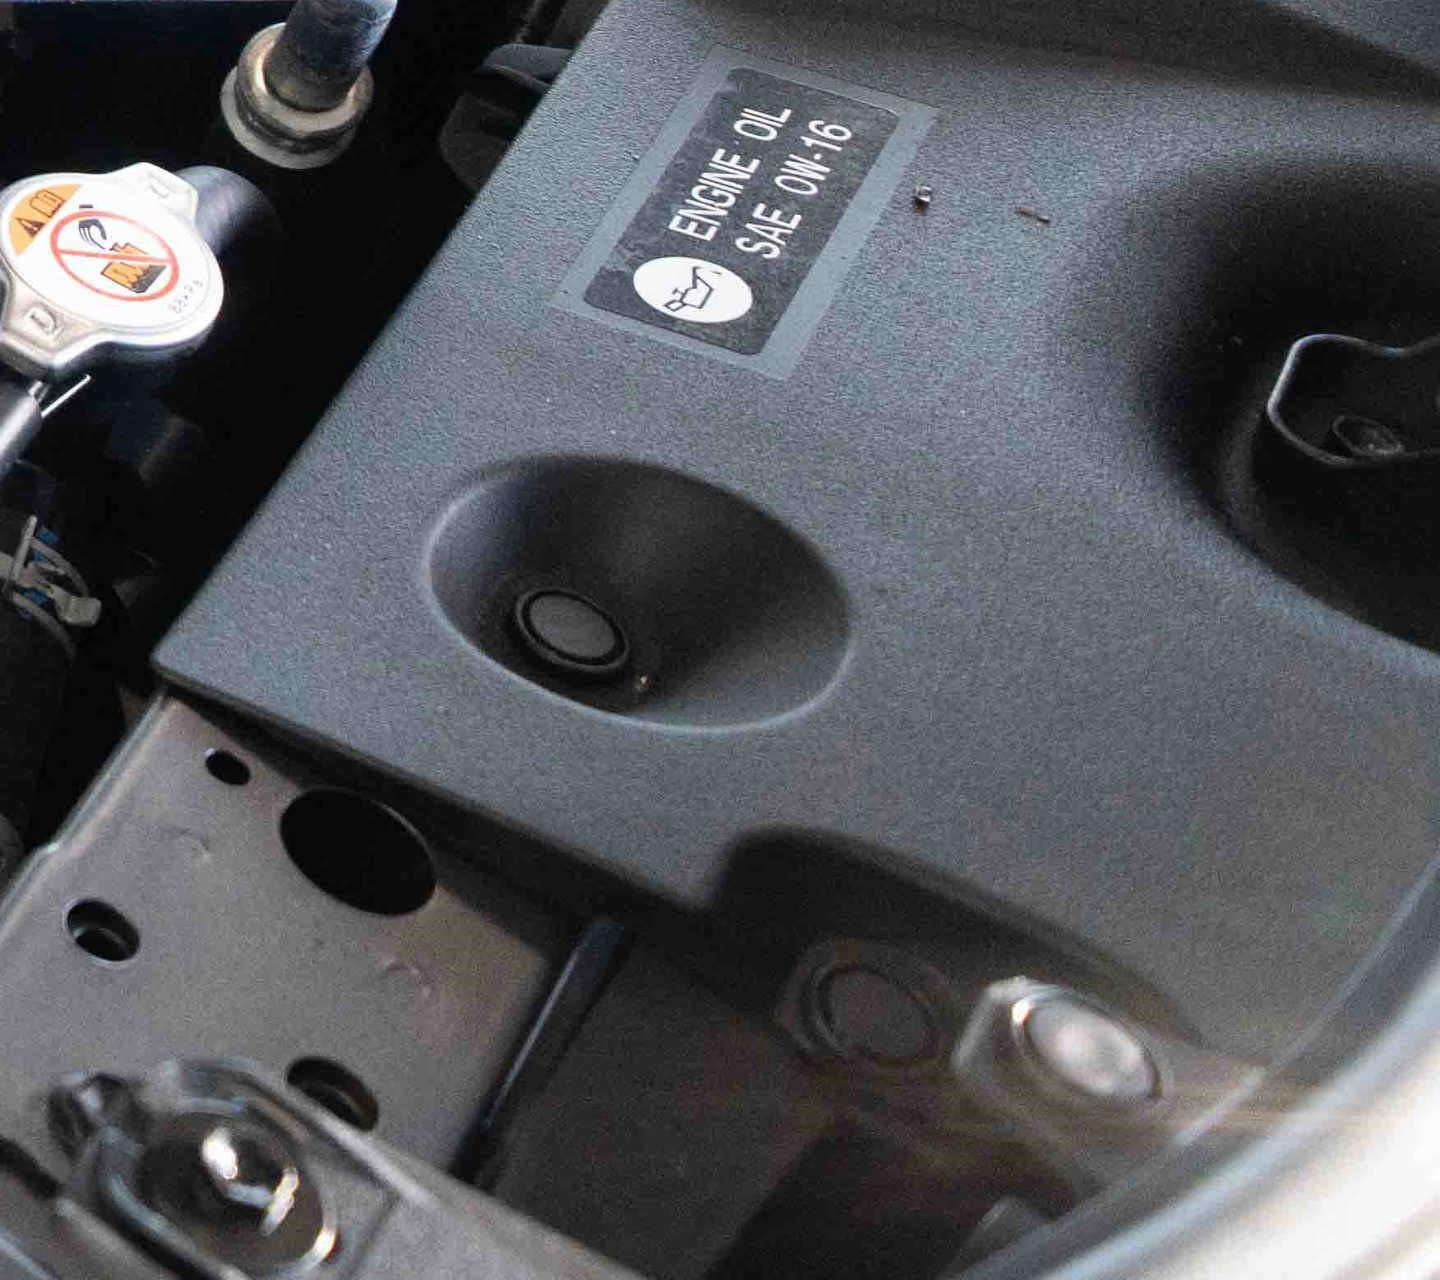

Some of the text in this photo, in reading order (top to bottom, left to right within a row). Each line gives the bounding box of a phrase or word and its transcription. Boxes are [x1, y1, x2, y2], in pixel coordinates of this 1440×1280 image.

[668, 108, 792, 241] ENGINE OIL
[735, 203, 802, 259] SAE
